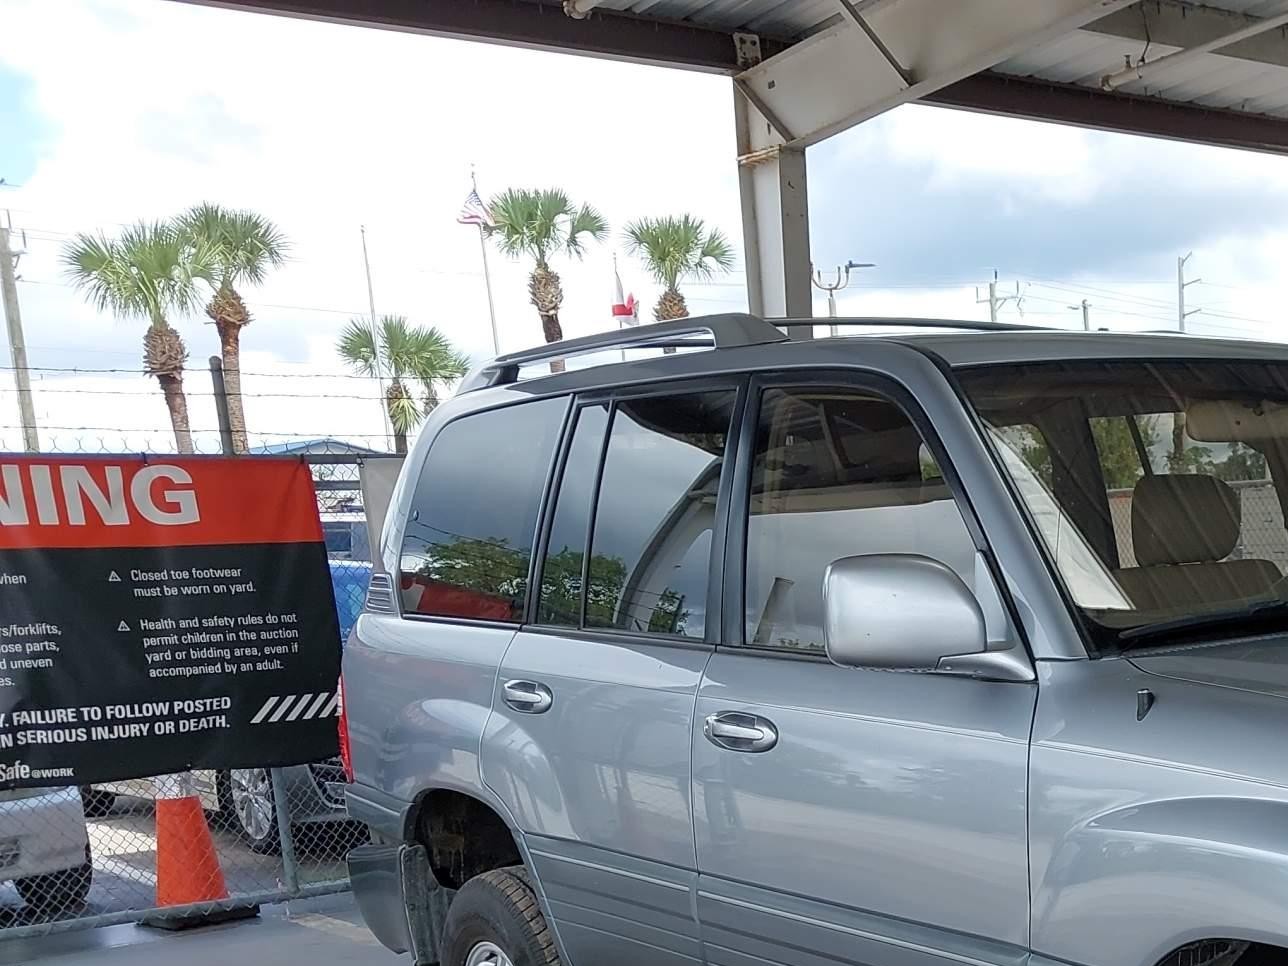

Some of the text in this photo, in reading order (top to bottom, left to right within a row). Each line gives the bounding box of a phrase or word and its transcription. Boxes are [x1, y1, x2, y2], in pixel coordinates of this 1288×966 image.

[130, 568, 242, 581] Closed toe footwear
[134, 581, 257, 597] must be worn on yard.
[139, 612, 297, 631] Health and safety rules do not
[25, 640, 60, 655] parts,
[143, 628, 299, 648] permit children in the auction
[145, 642, 299, 664] yard or bidding area, even if
[10, 658, 53, 670] uneven
[149, 658, 284, 678] accompanied by an adult.
[12, 708, 78, 726] FAILURE
[79, 706, 102, 721] TO
[105, 702, 170, 720] FOLLOW
[173, 696, 232, 714] POSTED
[16, 728, 88, 745] SERIOUS
[91, 723, 150, 741] INJURY
[154, 720, 176, 735] OR
[179, 715, 231, 733] DEATH.
